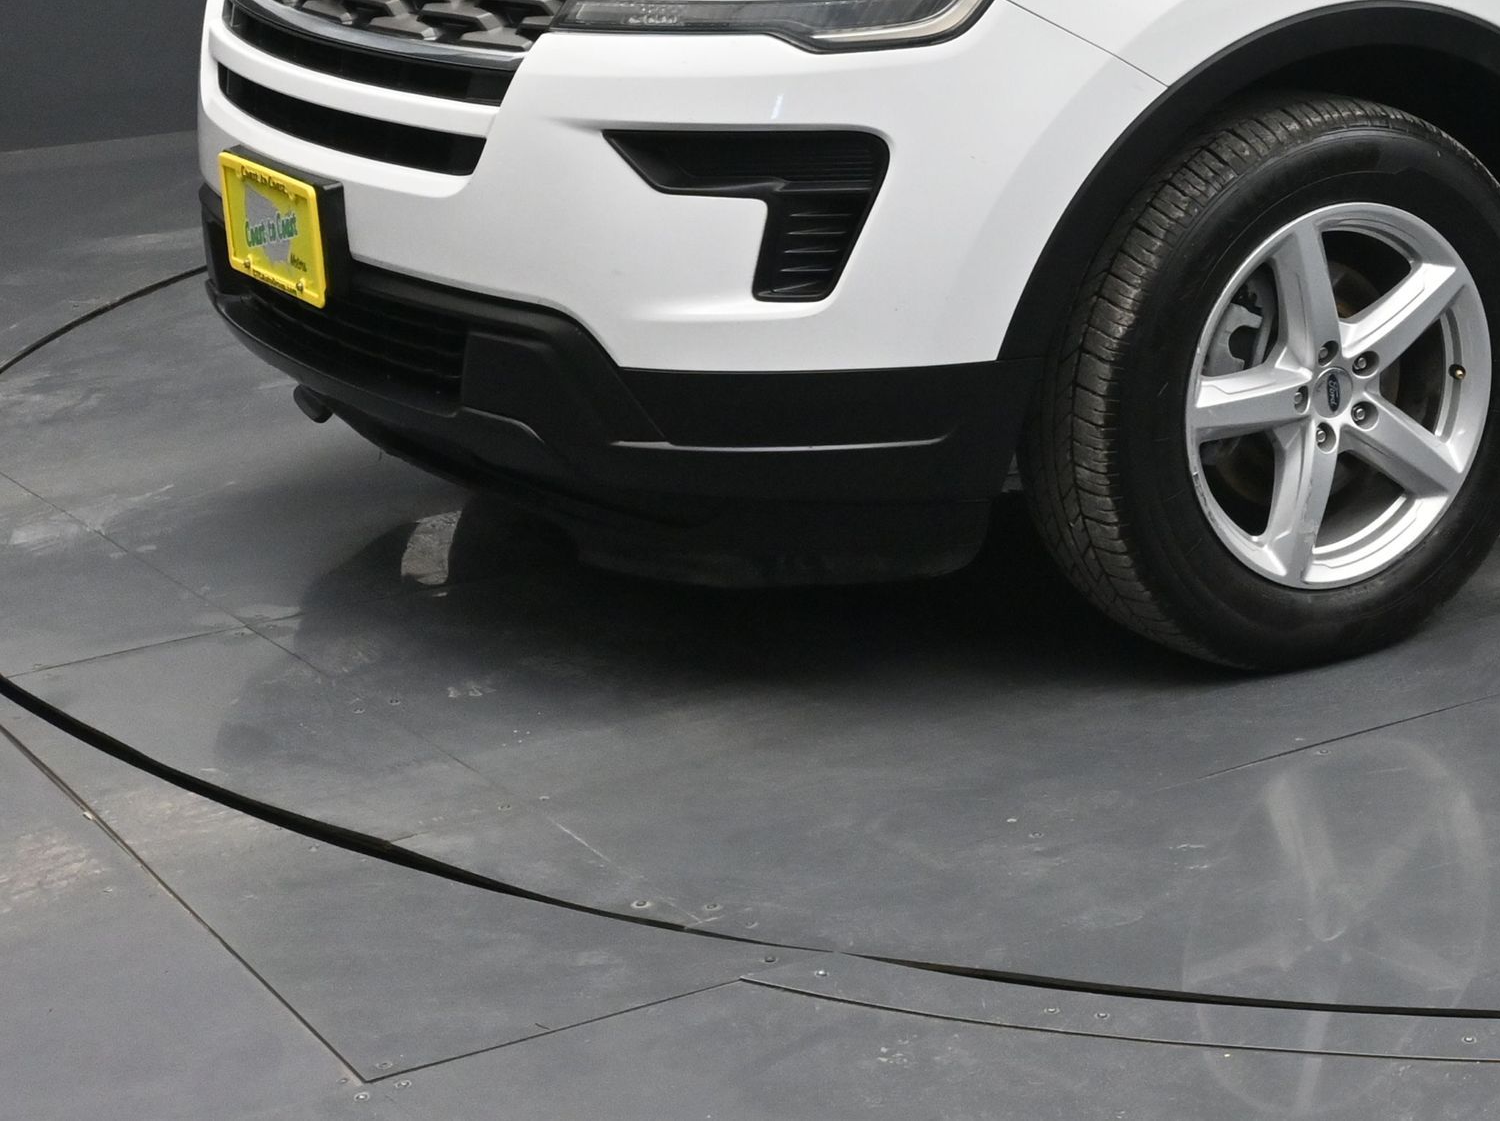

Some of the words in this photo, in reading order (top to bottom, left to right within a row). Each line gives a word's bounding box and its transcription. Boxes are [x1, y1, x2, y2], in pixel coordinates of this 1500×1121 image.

[244, 220, 267, 248] Coast
[276, 211, 299, 240] Coast
[1328, 379, 1339, 408] Ford
